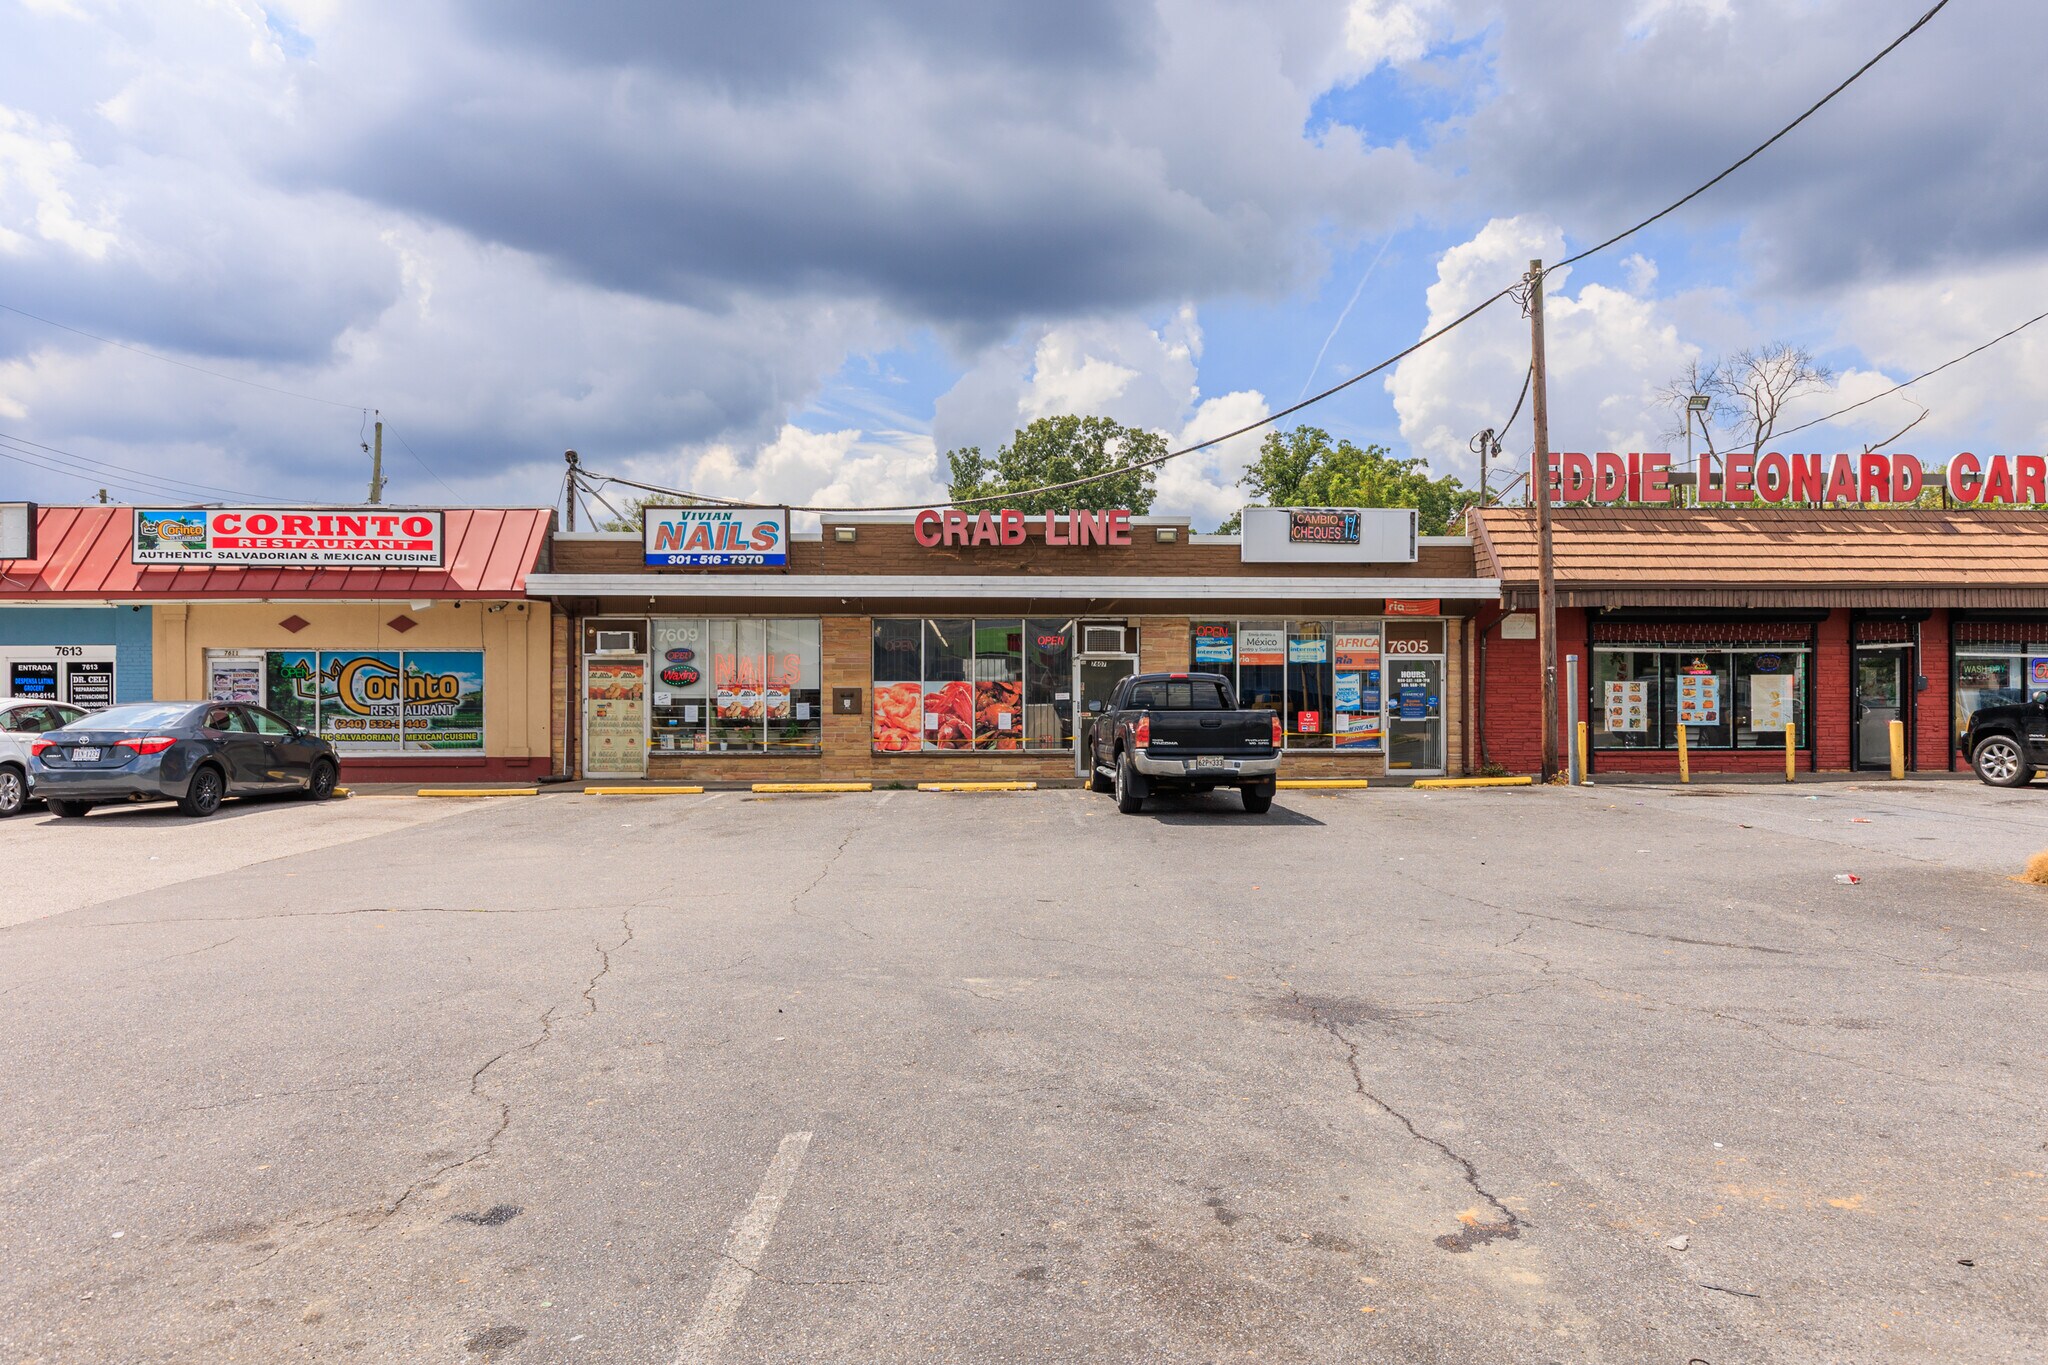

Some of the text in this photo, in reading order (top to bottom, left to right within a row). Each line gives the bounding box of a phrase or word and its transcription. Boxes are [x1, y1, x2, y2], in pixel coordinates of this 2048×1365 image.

[1531, 453, 1671, 503] EDDIE
[1697, 453, 1923, 504] LEONARD
[681, 511, 733, 521] VIVIAN
[1297, 514, 1338, 525] CAMBIO
[157, 519, 203, 540] Corinto
[212, 513, 434, 538] CORINTO
[914, 509, 1132, 547] CRAB LINE
[654, 521, 780, 551] NAILS
[1293, 526, 1342, 539] CHEQUES
[238, 538, 413, 550] RESTAURANT
[139, 551, 438, 562] AUTHENTIC SALVADORIAN & MEXICAN CUISINE
[1388, 601, 1405, 611] ria
[657, 628, 698, 642] 7609
[1196, 626, 1228, 638] OPEN
[1037, 636, 1065, 646] OPEN
[1246, 637, 1277, 646] México
[1336, 638, 1379, 648] AFRICA
[1388, 640, 1429, 654] 7605
[55, 647, 82, 656] 7613
[1336, 654, 1352, 664] Ria
[1757, 657, 1781, 668] OPEN
[281, 667, 308, 679] OPEN
[715, 653, 801, 685] NAILS
[1964, 665, 1987, 673] WASH
[663, 670, 698, 682] Waxing
[338, 657, 460, 716] Corinto
[370, 704, 455, 716] RESTAURANT
[335, 719, 427, 730] (240) 532-5446
[335, 733, 393, 742] SALVADORIAN
[406, 733, 442, 741] MEXICAN
[444, 732, 477, 741] CUISINE
